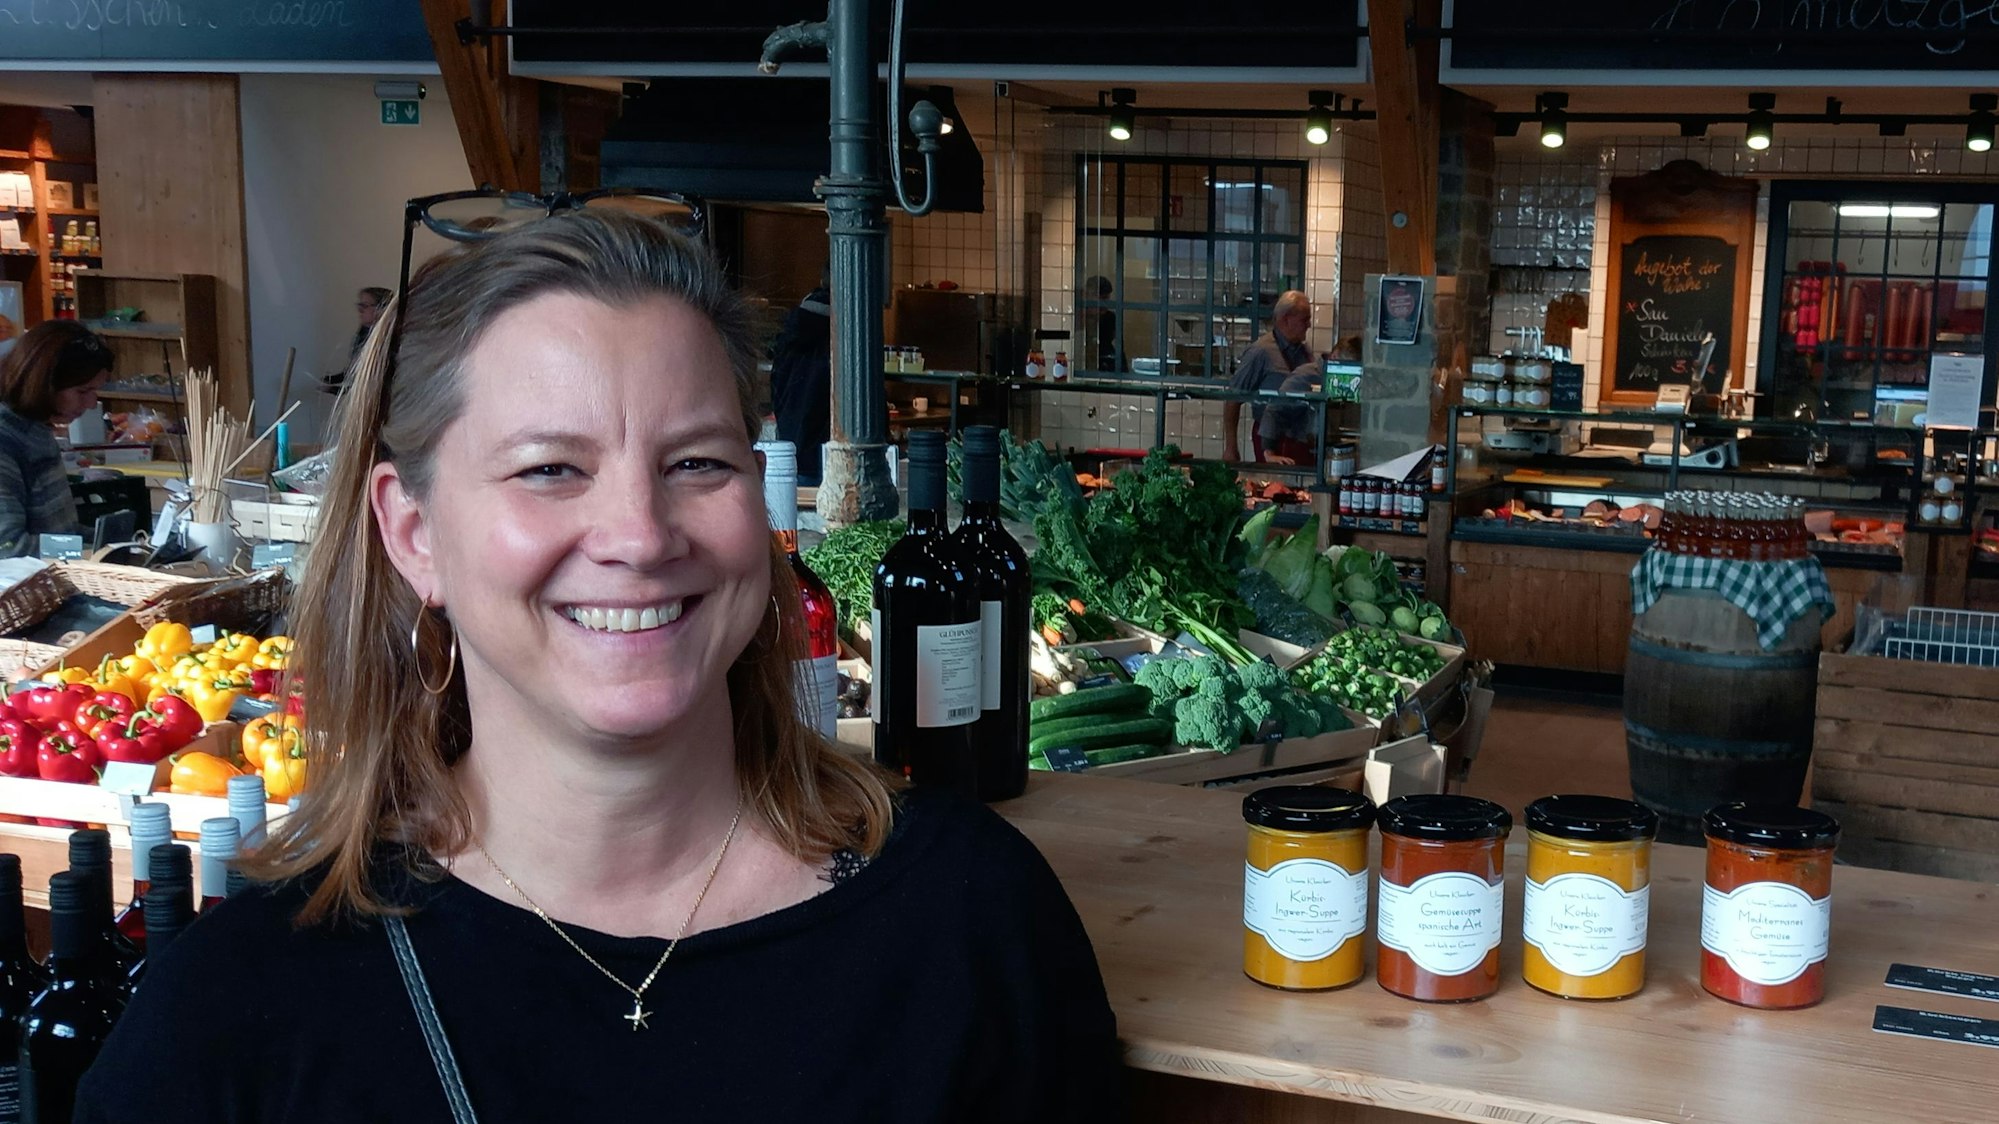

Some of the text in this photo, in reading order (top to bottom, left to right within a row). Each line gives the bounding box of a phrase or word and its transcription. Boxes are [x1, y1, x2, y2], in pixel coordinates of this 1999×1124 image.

[1420, 902, 1482, 917] Gemüsesuppe
[1418, 917, 1482, 931] spanische Art
[1750, 926, 1791, 940] Gemüse
